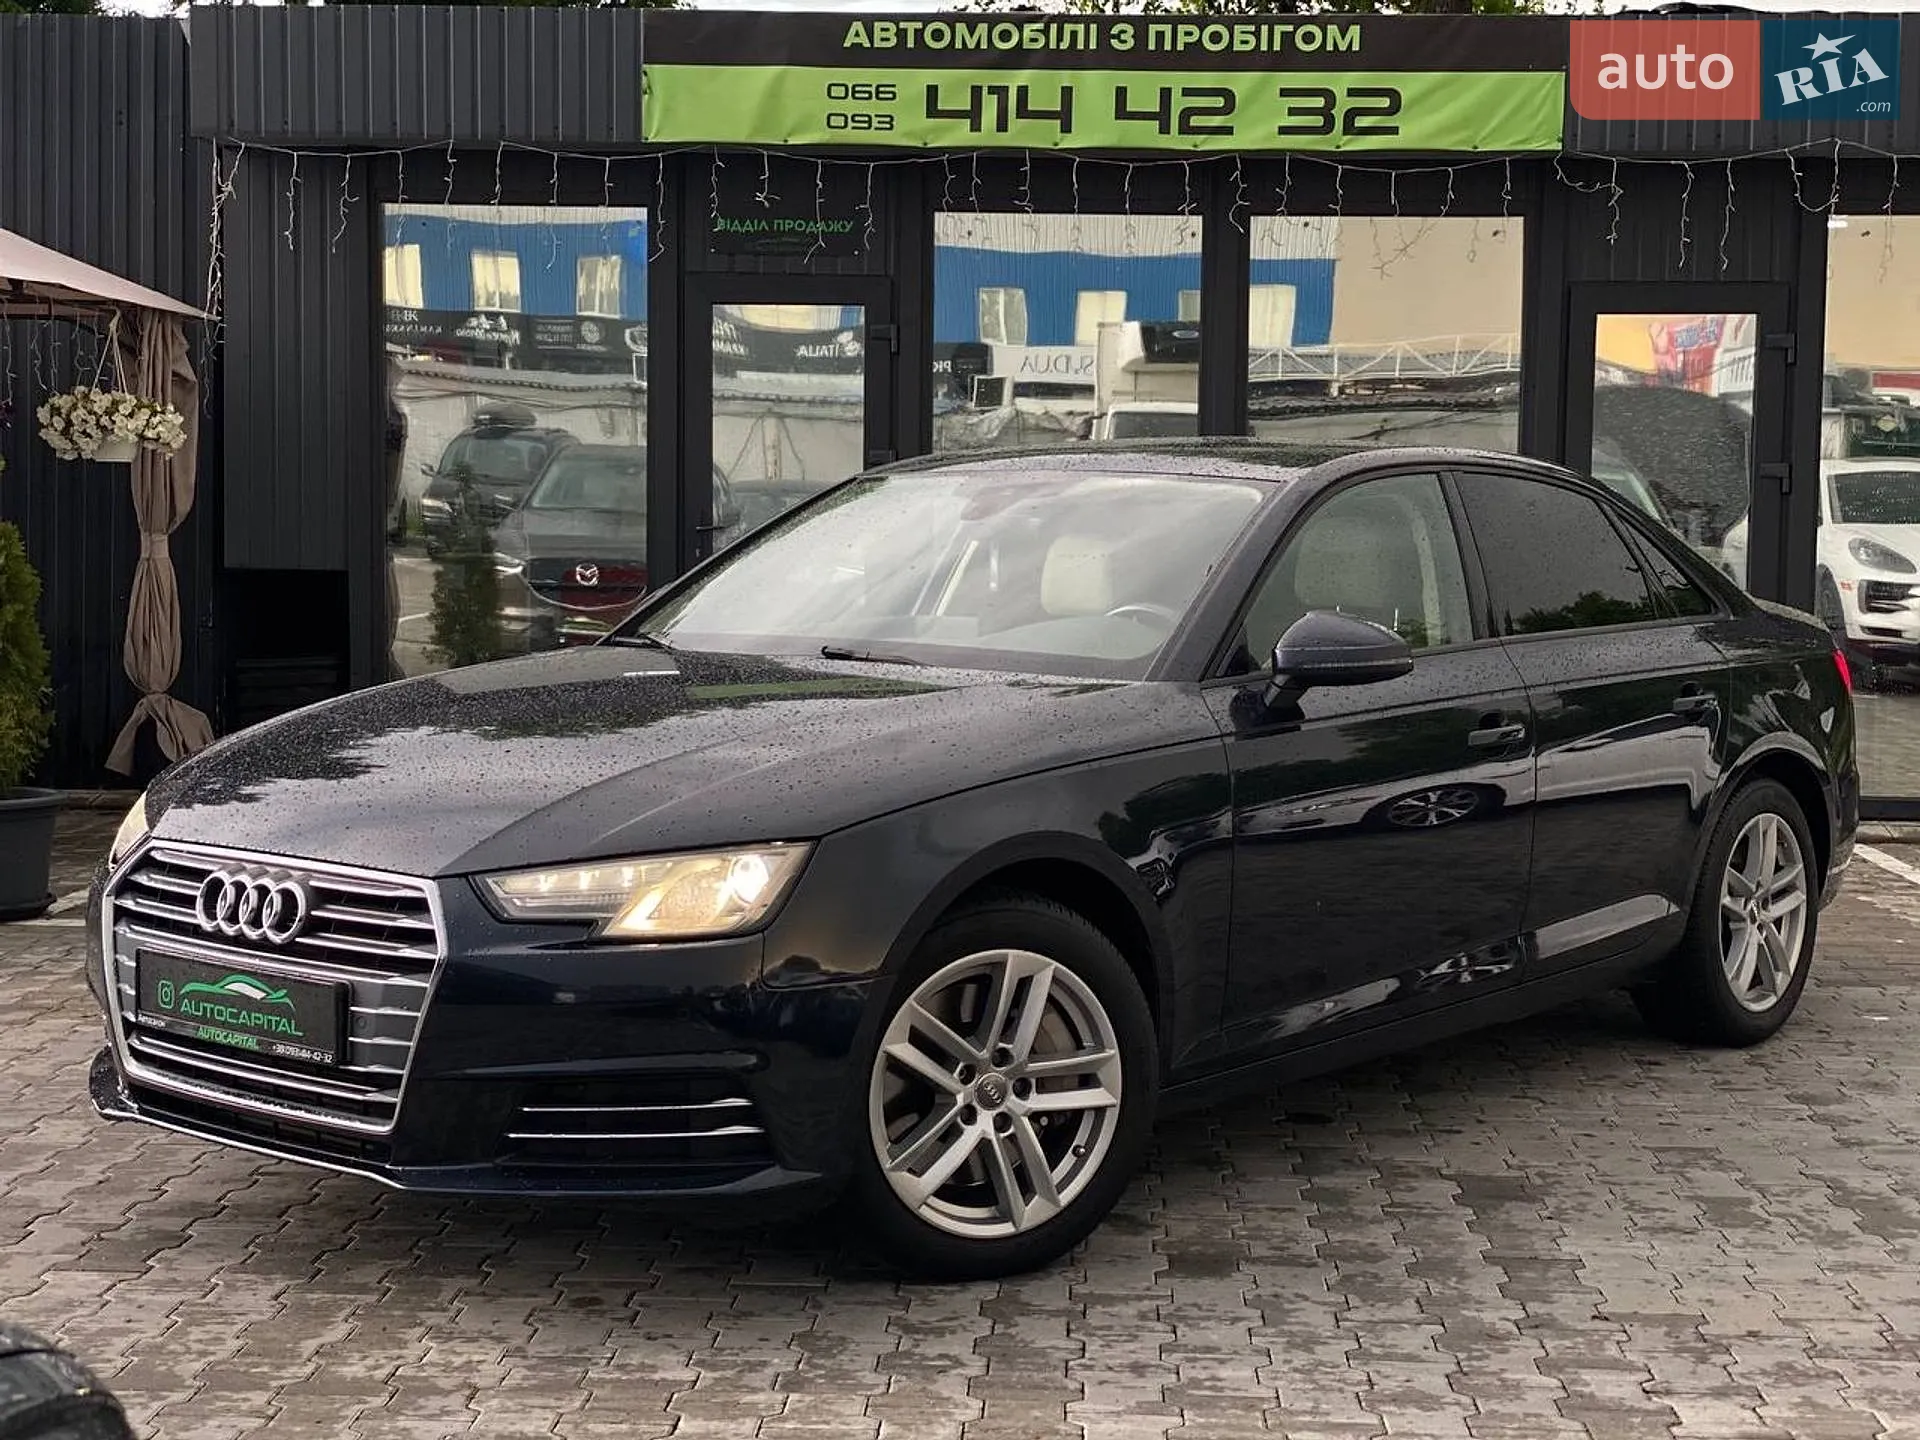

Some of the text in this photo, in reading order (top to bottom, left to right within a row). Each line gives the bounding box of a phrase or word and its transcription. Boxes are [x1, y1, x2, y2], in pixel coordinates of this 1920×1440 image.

[843, 21, 1362, 54] АВТОМОБІЛІ З ПРОБІГОМ
[826, 82, 897, 101] 066
[826, 112, 896, 132] 093
[926, 84, 1402, 137] 414 42 32
[716, 218, 853, 233] ВІДДІЛ ПРОДАЖУ
[180, 999, 304, 1037] AUTOCAPITAL
[196, 1026, 261, 1051] AUTOCAPITAL
